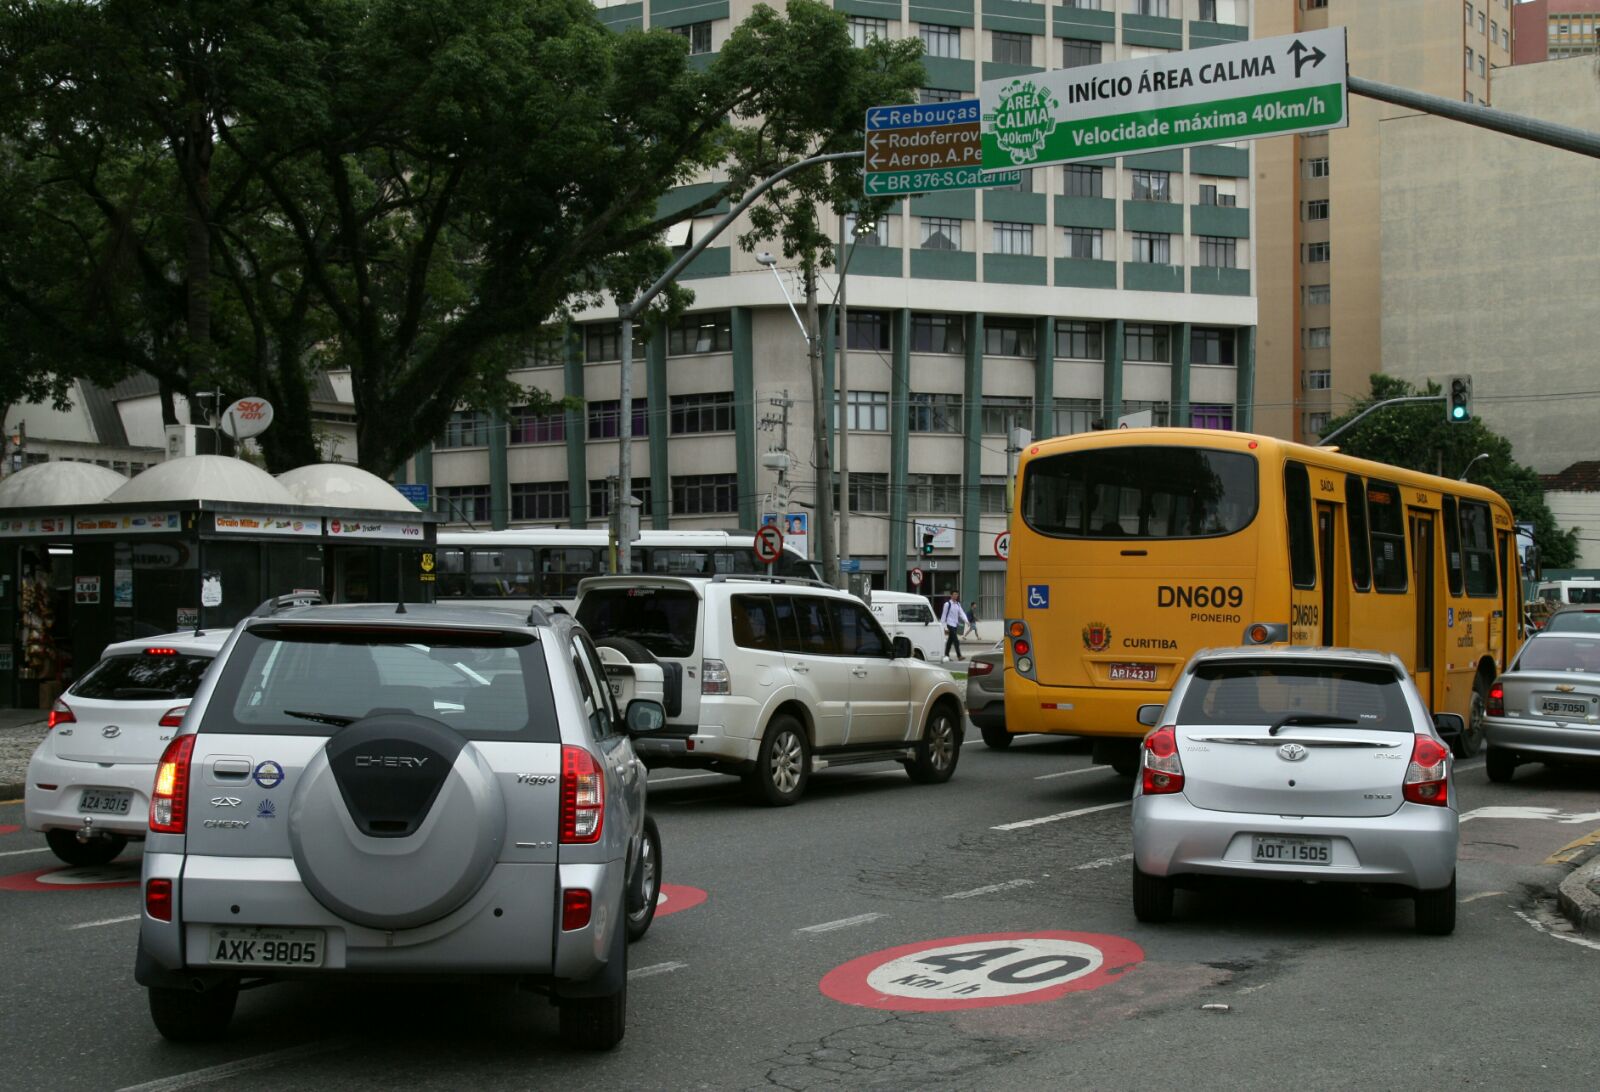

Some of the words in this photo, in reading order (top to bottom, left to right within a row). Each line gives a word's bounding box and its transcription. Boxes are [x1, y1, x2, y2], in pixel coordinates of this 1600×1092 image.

[1068, 76, 1133, 104] INÍCIO
[1137, 68, 1194, 95] ÁREA
[1198, 55, 1276, 85] CALMA
[889, 106, 977, 125] Rebouças
[996, 107, 1049, 129] CALMA
[1071, 118, 1170, 147] Velocidade
[1173, 113, 1248, 134] máxima
[1251, 96, 1326, 123] 40km/h
[888, 130, 981, 149] Rodoferrov
[888, 152, 943, 168] Aerop.
[946, 148, 961, 163] A.
[963, 147, 983, 161] Pe
[887, 175, 911, 190] BR
[237, 401, 265, 411] SKY
[999, 538, 1008, 551] 4
[1157, 585, 1243, 608] DN609
[1190, 613, 1241, 624] PIONEIRO
[1292, 604, 1319, 626] DN609
[1122, 638, 1178, 649] CURITIBA
[355, 755, 429, 768] CHERY
[516, 773, 557, 785] Tiggo
[203, 819, 250, 829] CHERY
[915, 946, 1091, 984] 40
